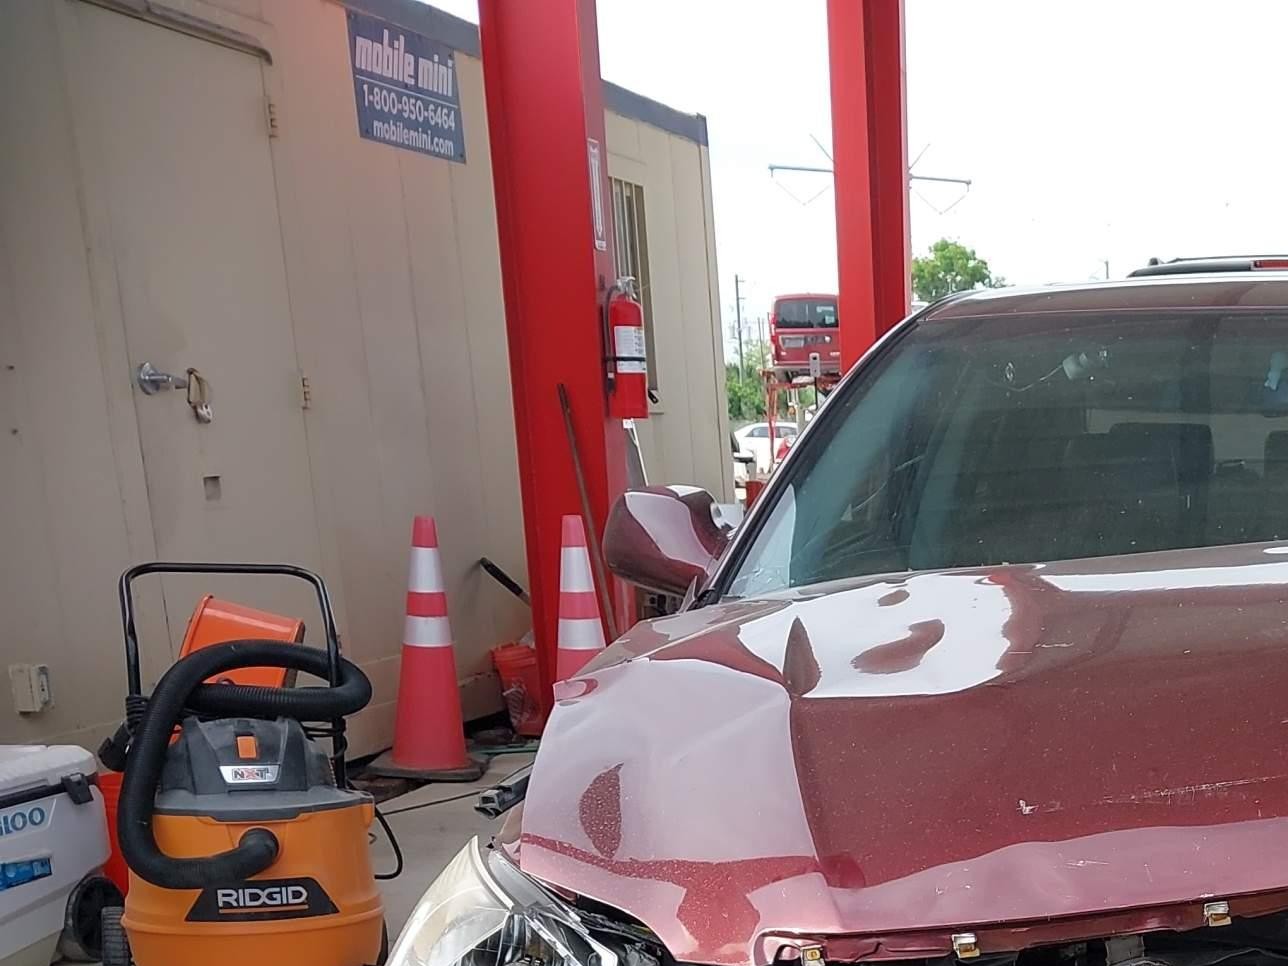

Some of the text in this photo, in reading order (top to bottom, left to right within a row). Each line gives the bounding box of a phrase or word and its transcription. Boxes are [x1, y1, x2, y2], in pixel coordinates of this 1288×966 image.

[355, 28, 454, 97] mobile mini
[362, 84, 456, 131] 1-800-950-6464
[373, 119, 455, 157] mobilemini.com
[0, 806, 45, 836] LOO
[216, 885, 308, 907] RIDGID
